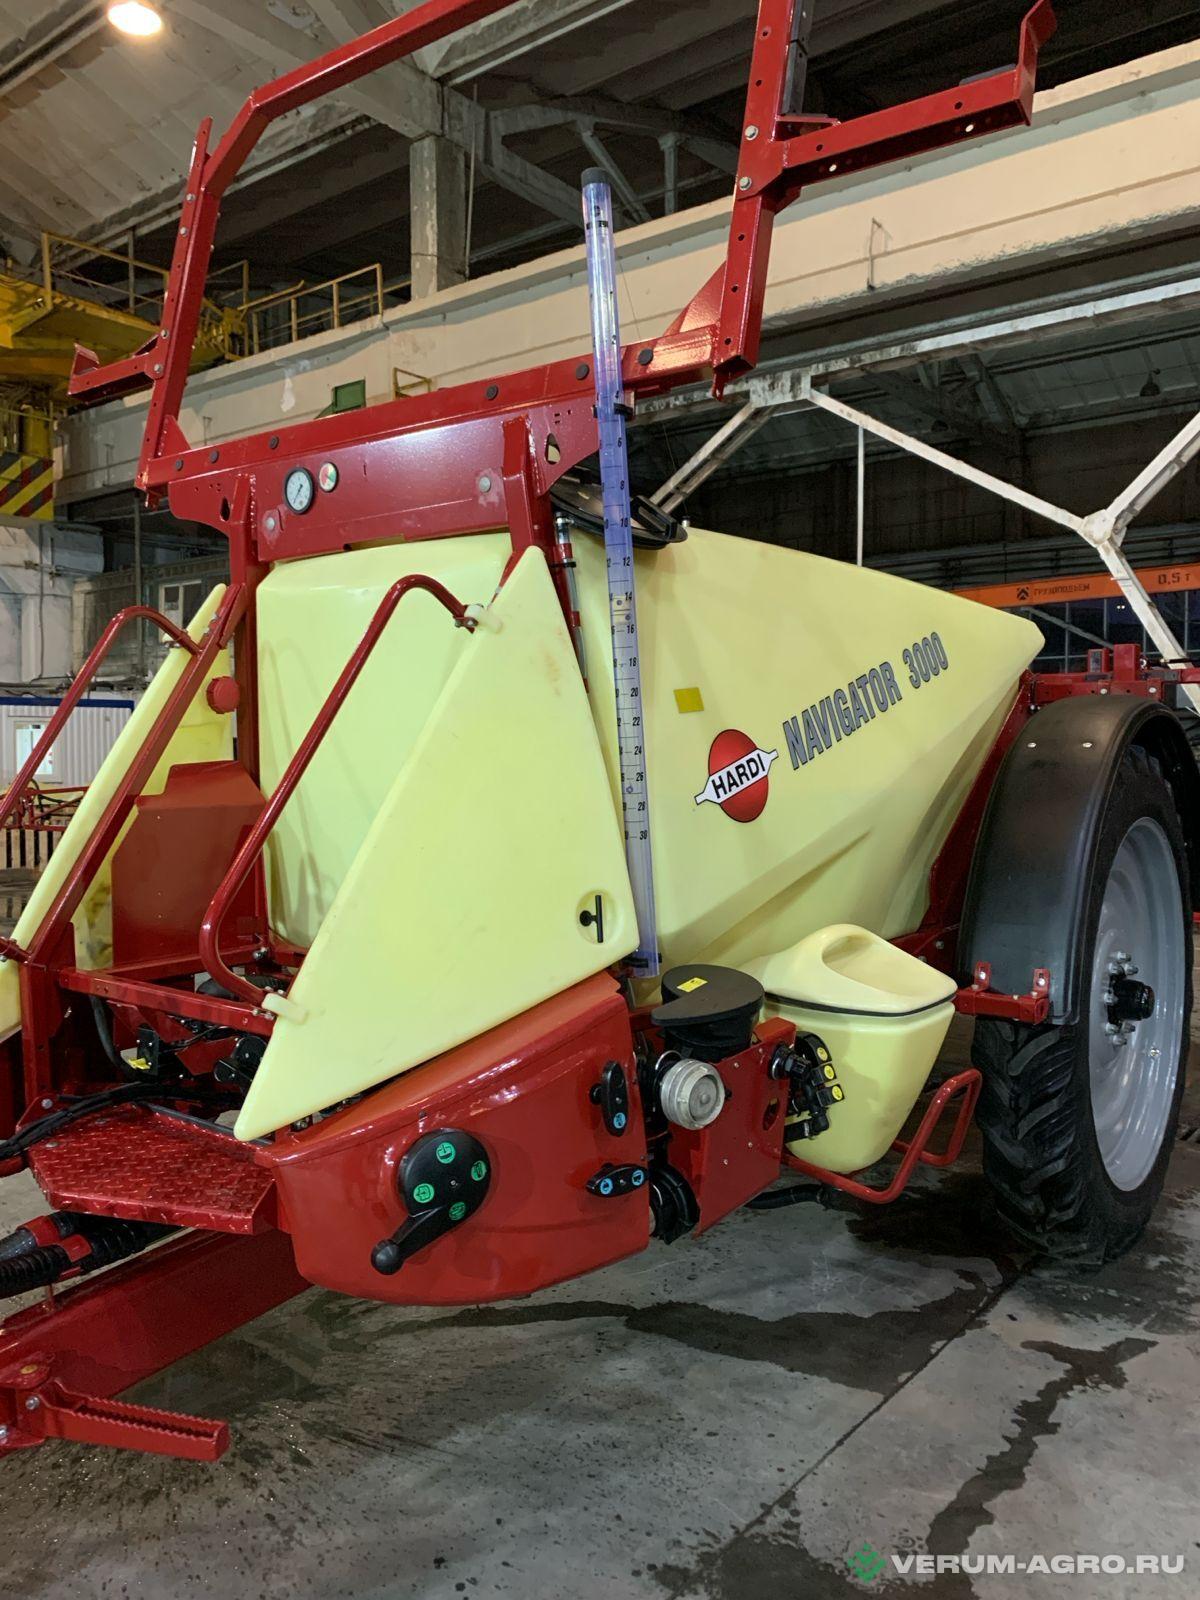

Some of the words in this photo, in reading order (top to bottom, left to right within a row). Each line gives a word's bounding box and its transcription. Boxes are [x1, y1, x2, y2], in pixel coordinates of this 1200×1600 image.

[617, 437, 622, 448] 6
[620, 480, 625, 490] 8
[620, 517, 629, 528] 10
[623, 556, 630, 567] 12
[624, 591, 632, 601] 14
[627, 624, 635, 634] 16
[629, 656, 637, 667] 18
[630, 687, 639, 698] 20
[782, 661, 903, 771] NAVIGATOR
[902, 631, 949, 690] 3000
[632, 716, 641, 727] 22
[634, 745, 642, 756] 24
[636, 771, 644, 782] 26
[711, 752, 766, 799] HARDI
[637, 801, 646, 812] 28
[639, 829, 648, 840] 30
